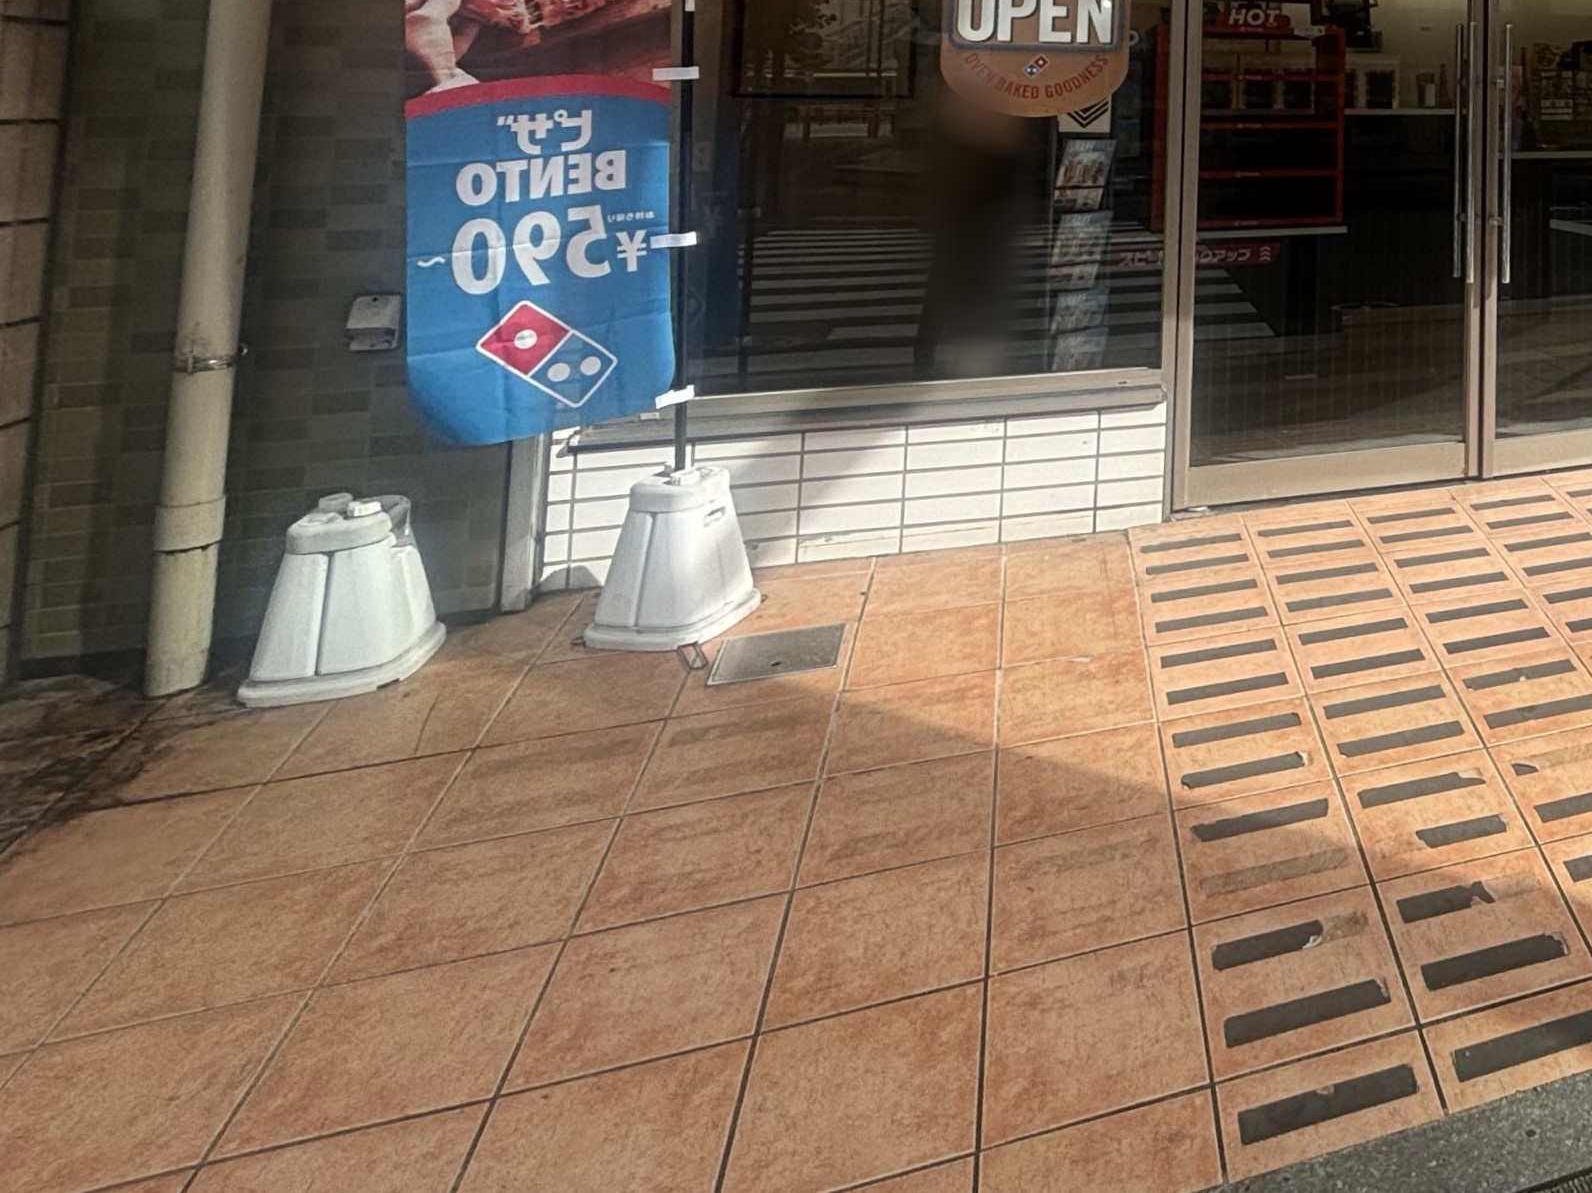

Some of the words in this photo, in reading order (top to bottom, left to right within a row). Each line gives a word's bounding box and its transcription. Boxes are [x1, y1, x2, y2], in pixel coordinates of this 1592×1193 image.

[1228, 8, 1282, 26] HOT
[994, 77, 1040, 100] BAKED
[1044, 53, 1109, 99] GOODNESS
